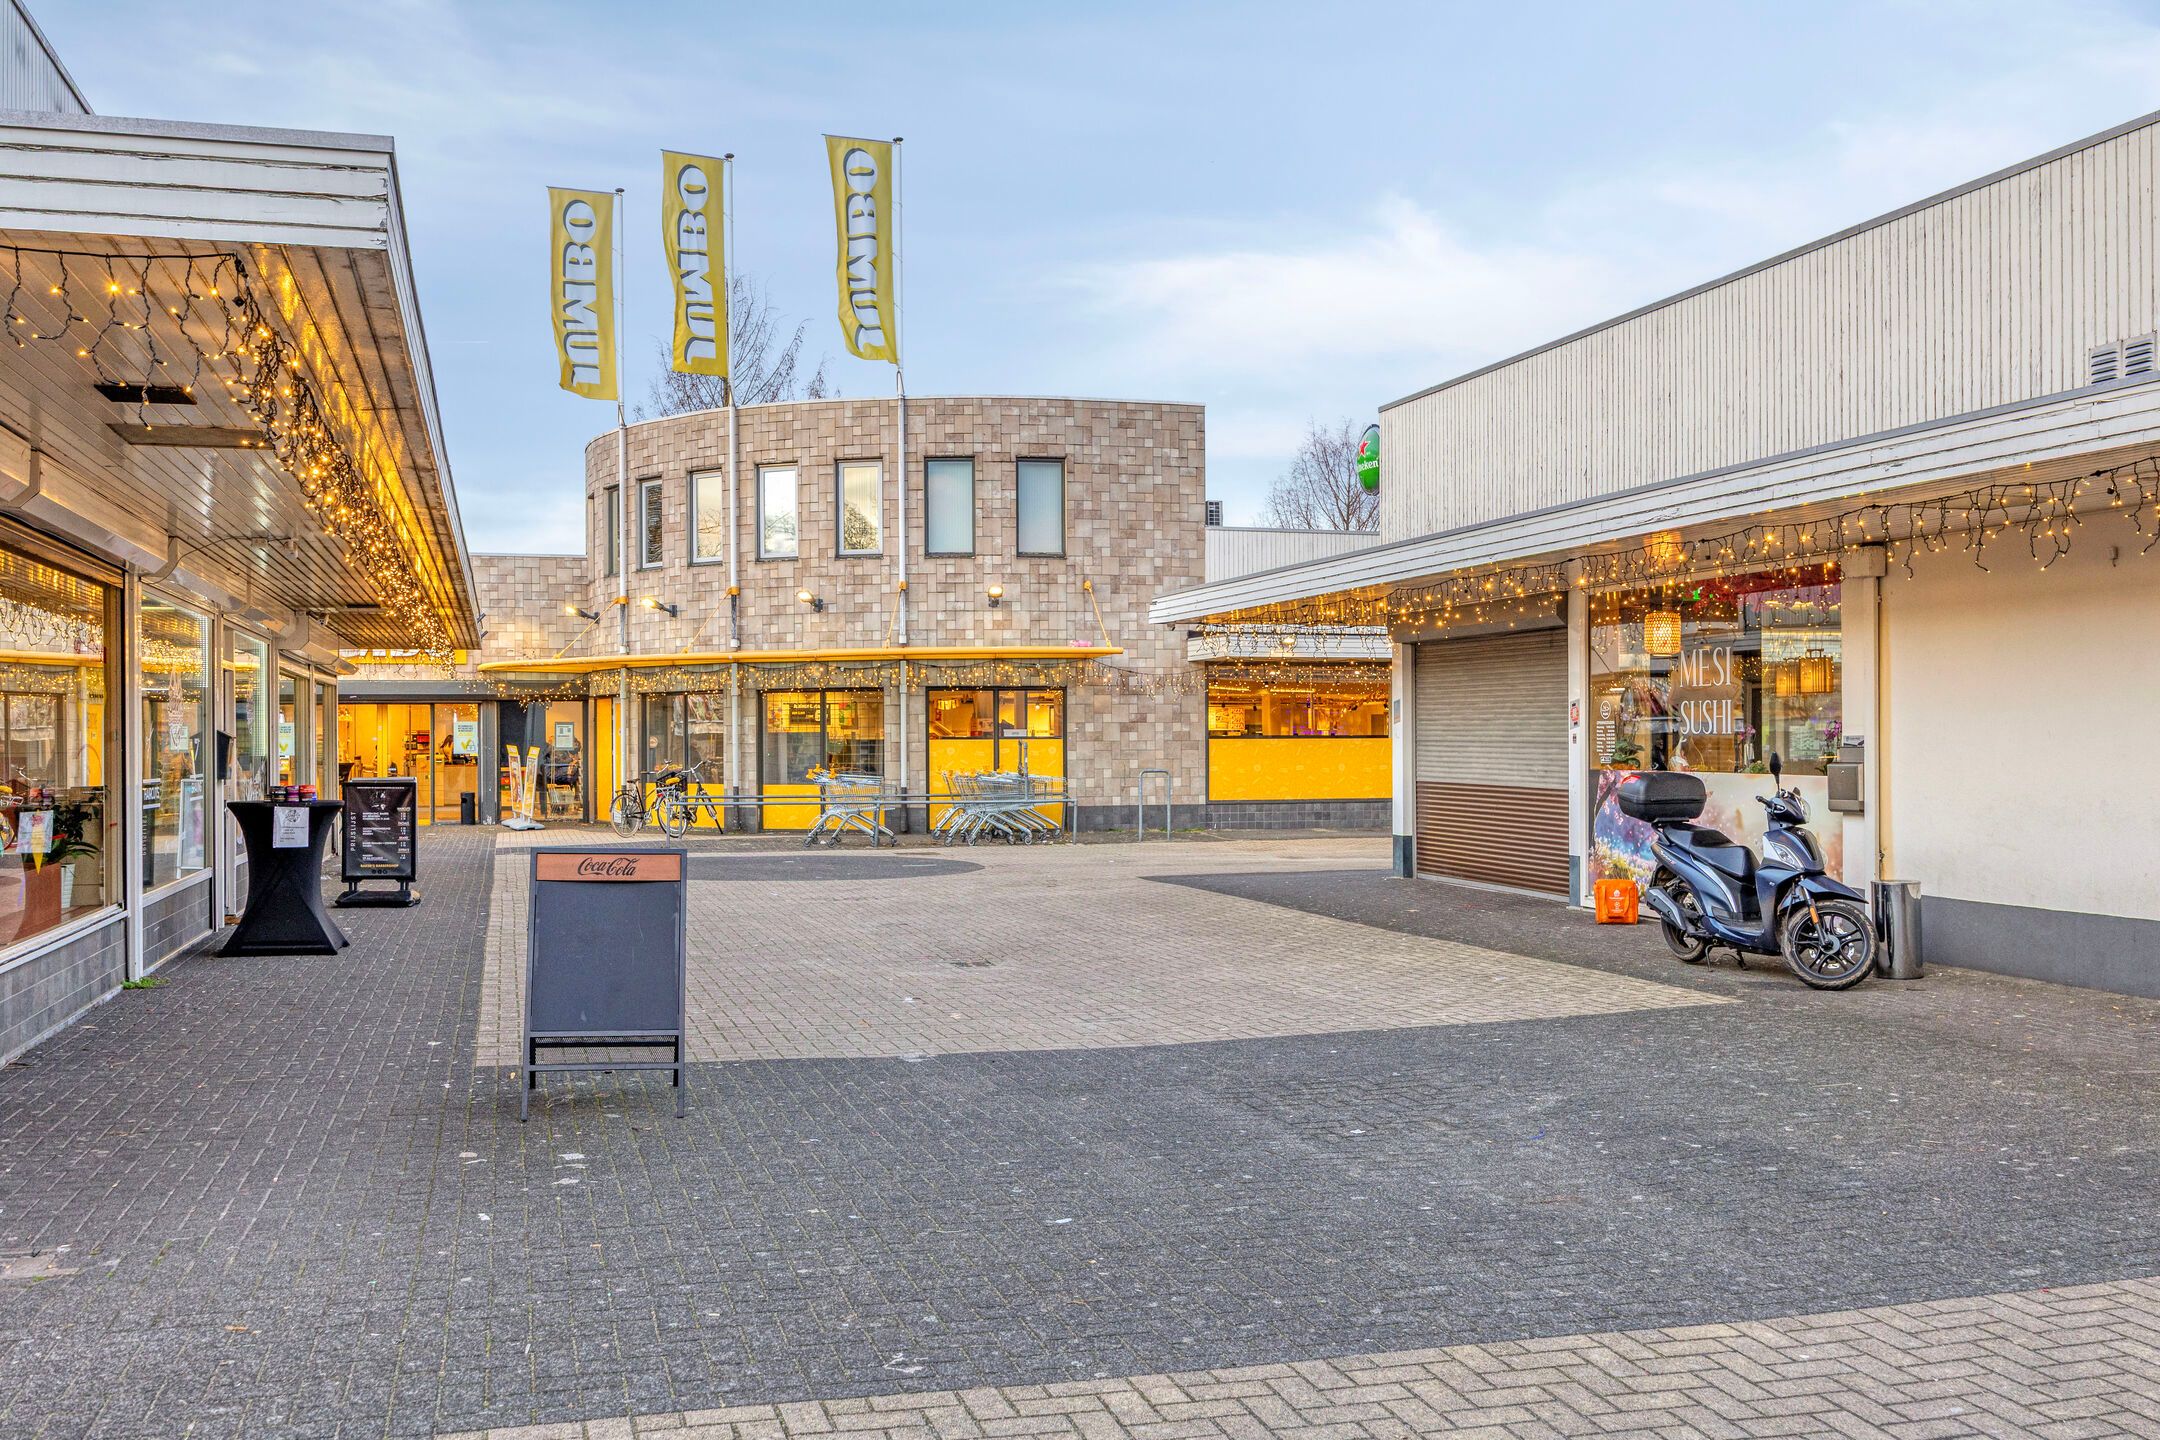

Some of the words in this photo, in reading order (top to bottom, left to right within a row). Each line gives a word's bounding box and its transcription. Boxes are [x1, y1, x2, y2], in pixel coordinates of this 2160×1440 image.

[1680, 646, 1732, 688] MESI
[1680, 699, 1732, 735] SUSHI
[577, 856, 640, 876] Coca-Cola
